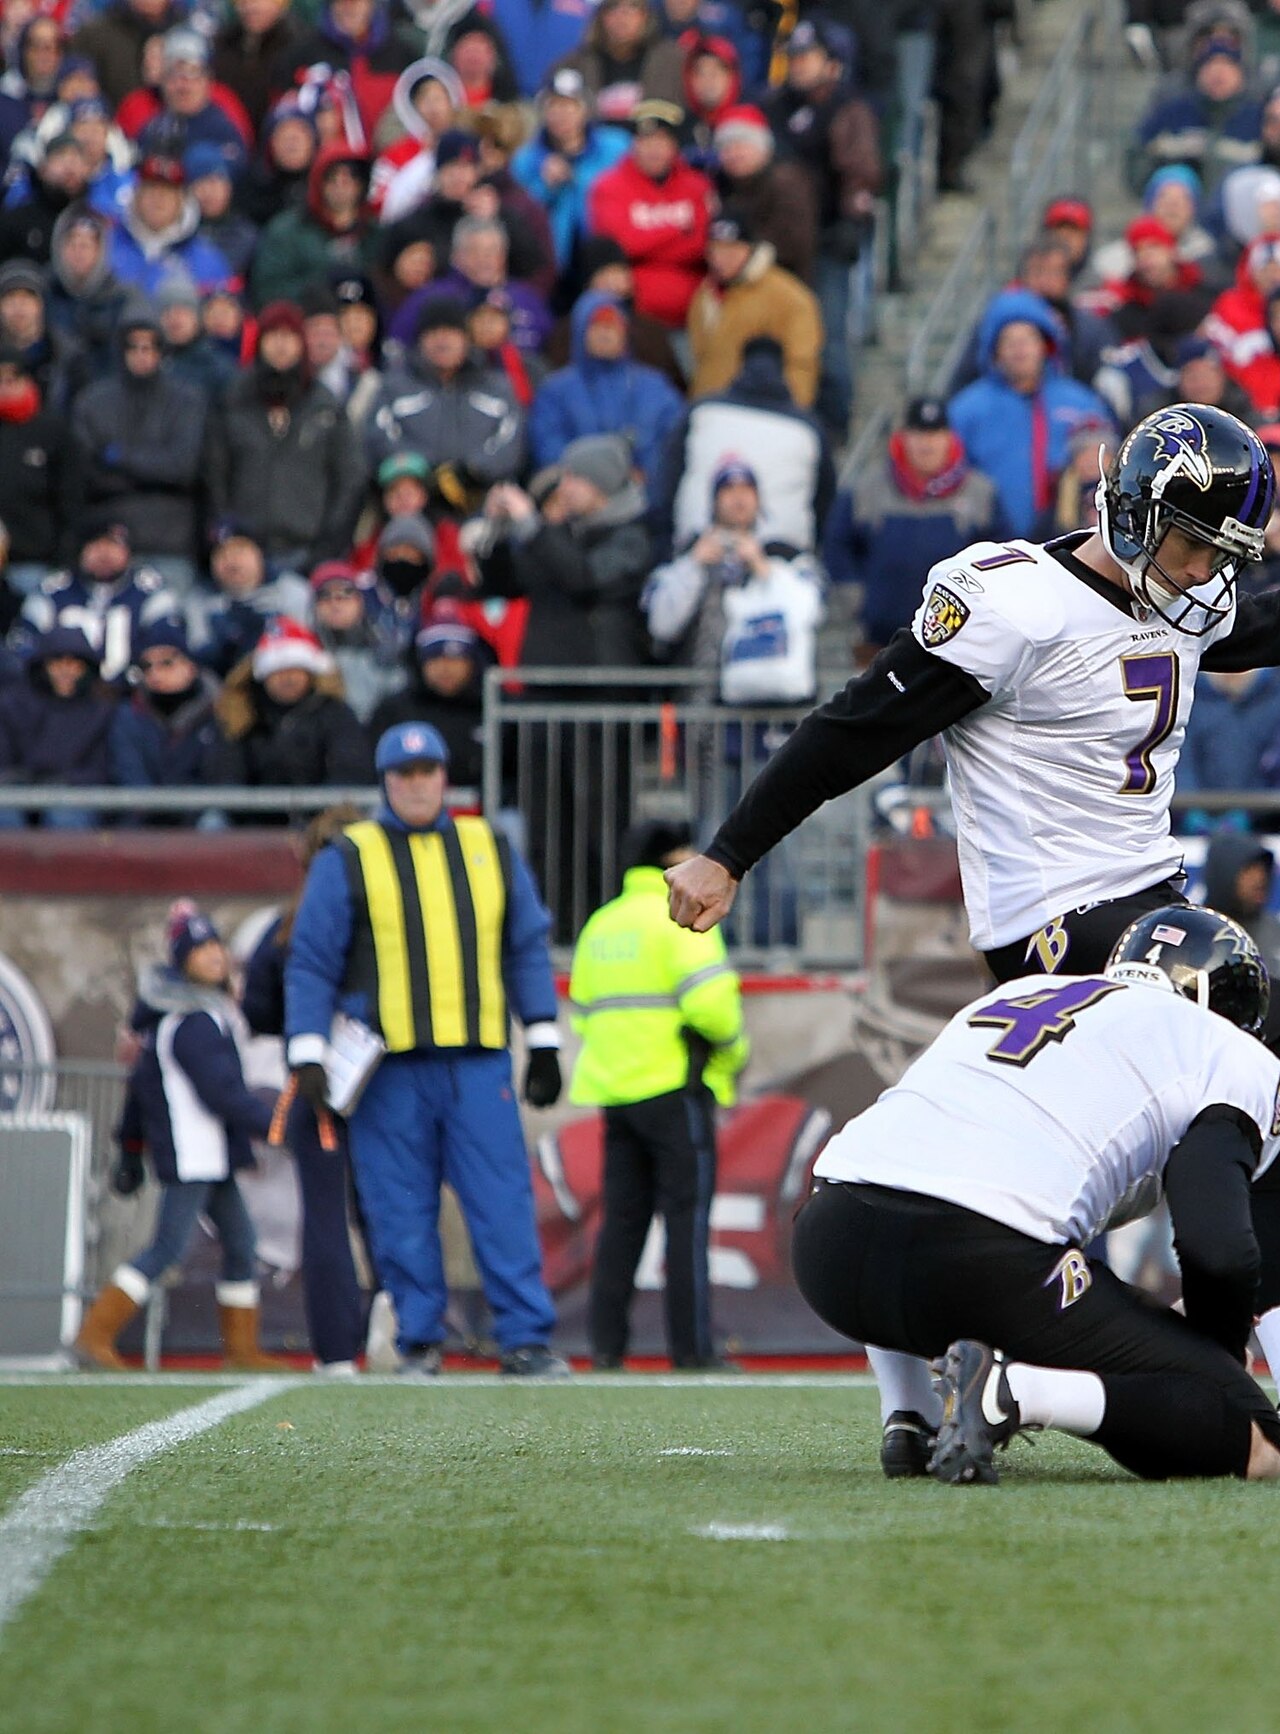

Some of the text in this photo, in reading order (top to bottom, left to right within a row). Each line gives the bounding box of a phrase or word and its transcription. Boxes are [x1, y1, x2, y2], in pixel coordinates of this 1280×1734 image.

[935, 584, 967, 616] RAVENS
[1130, 629, 1169, 642] RAVENS
[1117, 650, 1180, 795] 7
[1144, 943, 1163, 966] 4
[967, 978, 1130, 1070] 4
[1041, 1247, 1094, 1310] B
